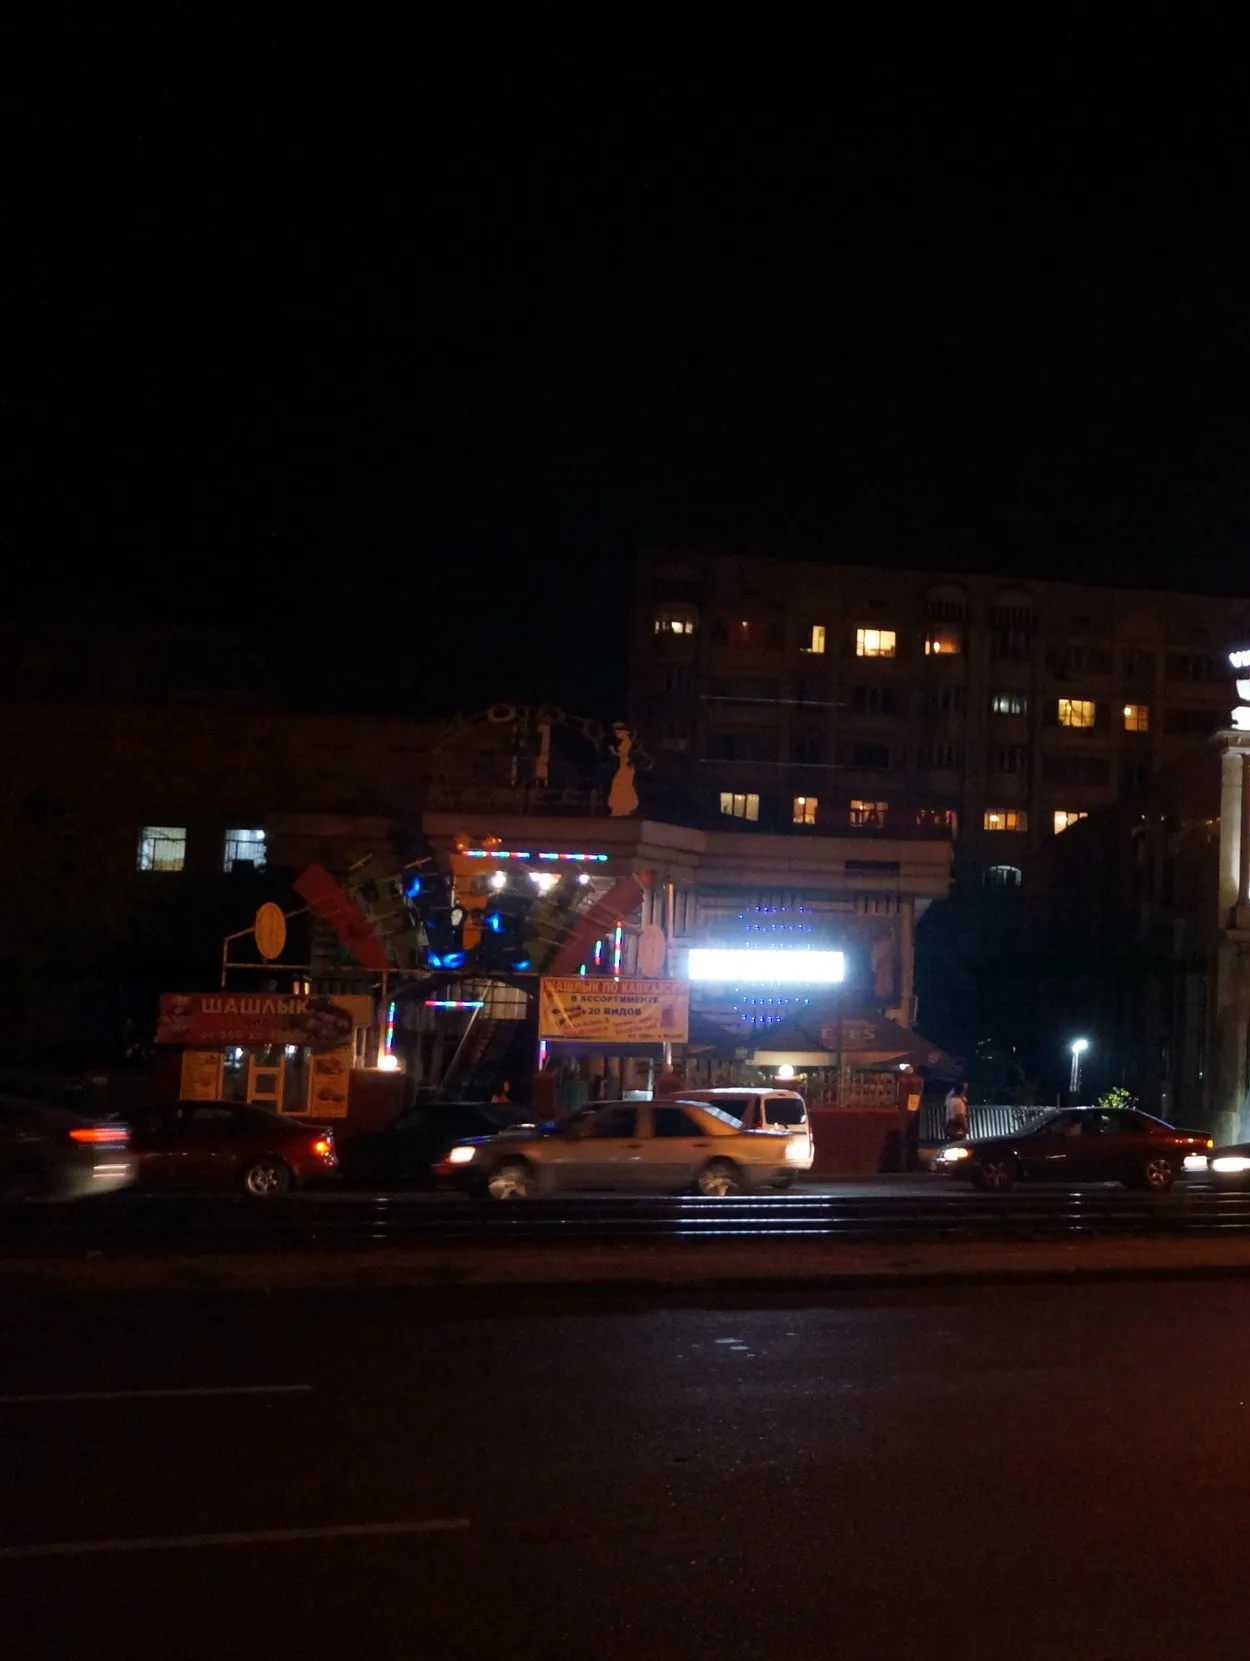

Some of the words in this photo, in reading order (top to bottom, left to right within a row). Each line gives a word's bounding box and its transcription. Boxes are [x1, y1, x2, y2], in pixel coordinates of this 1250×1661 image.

[544, 981, 599, 994] АШЛЫК
[202, 998, 309, 1015] ШАШЛЫК
[603, 1007, 642, 1017] ВИДОВ
[821, 1028, 876, 1041] EES
